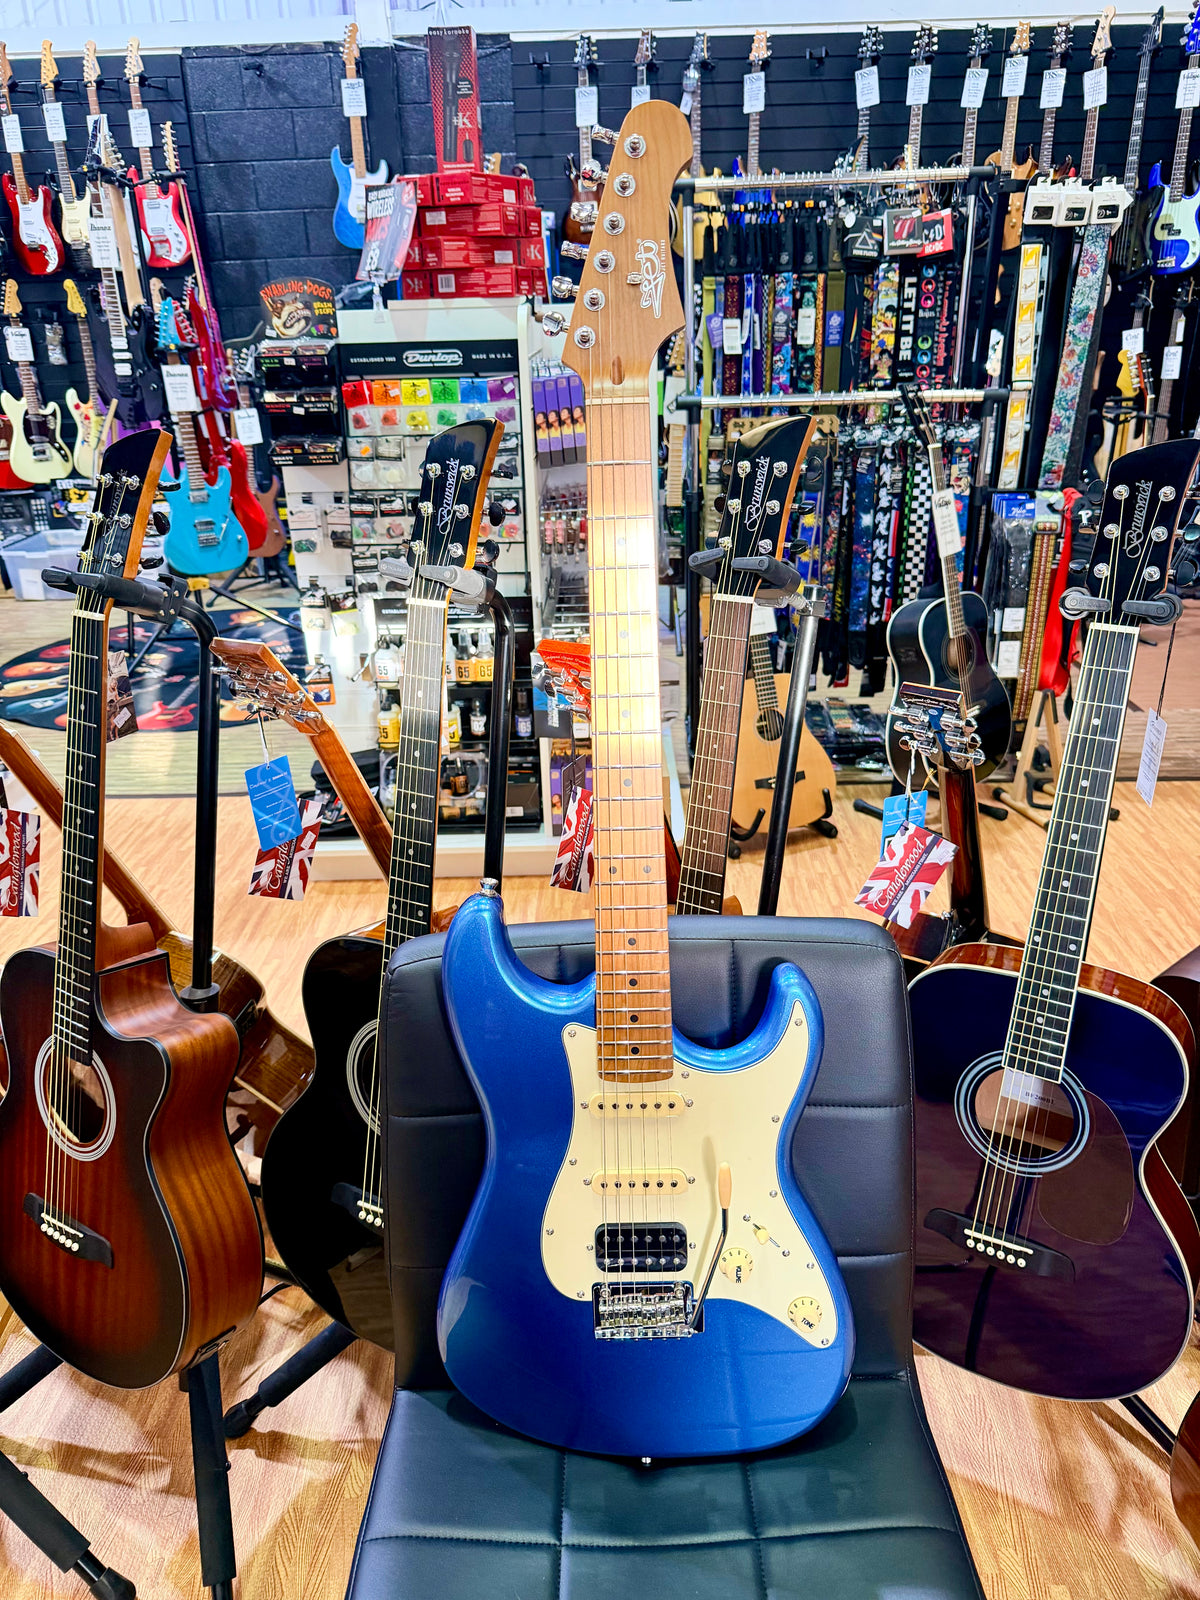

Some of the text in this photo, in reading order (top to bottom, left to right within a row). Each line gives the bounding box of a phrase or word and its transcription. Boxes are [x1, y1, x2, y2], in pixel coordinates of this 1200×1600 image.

[366, 196, 394, 220] WIRELESS
[90, 223, 111, 232] Ibanez
[925, 241, 944, 254] AC/DC
[260, 281, 304, 302] SNARLING
[899, 276, 918, 361] LET IT BE
[406, 352, 460, 367] Dunlop
[436, 457, 460, 535] Brunswick
[743, 455, 771, 532] Brunswick
[1122, 479, 1153, 559] Brunswick
[378, 665, 388, 676] 65
[457, 666, 470, 679] 65
[479, 665, 492, 677] 65
[564, 800, 590, 885] Tanglewood
[8, 821, 21, 911] Tanglewood
[872, 837, 925, 910] Tanglewood
[801, 1317, 816, 1330] TONE
